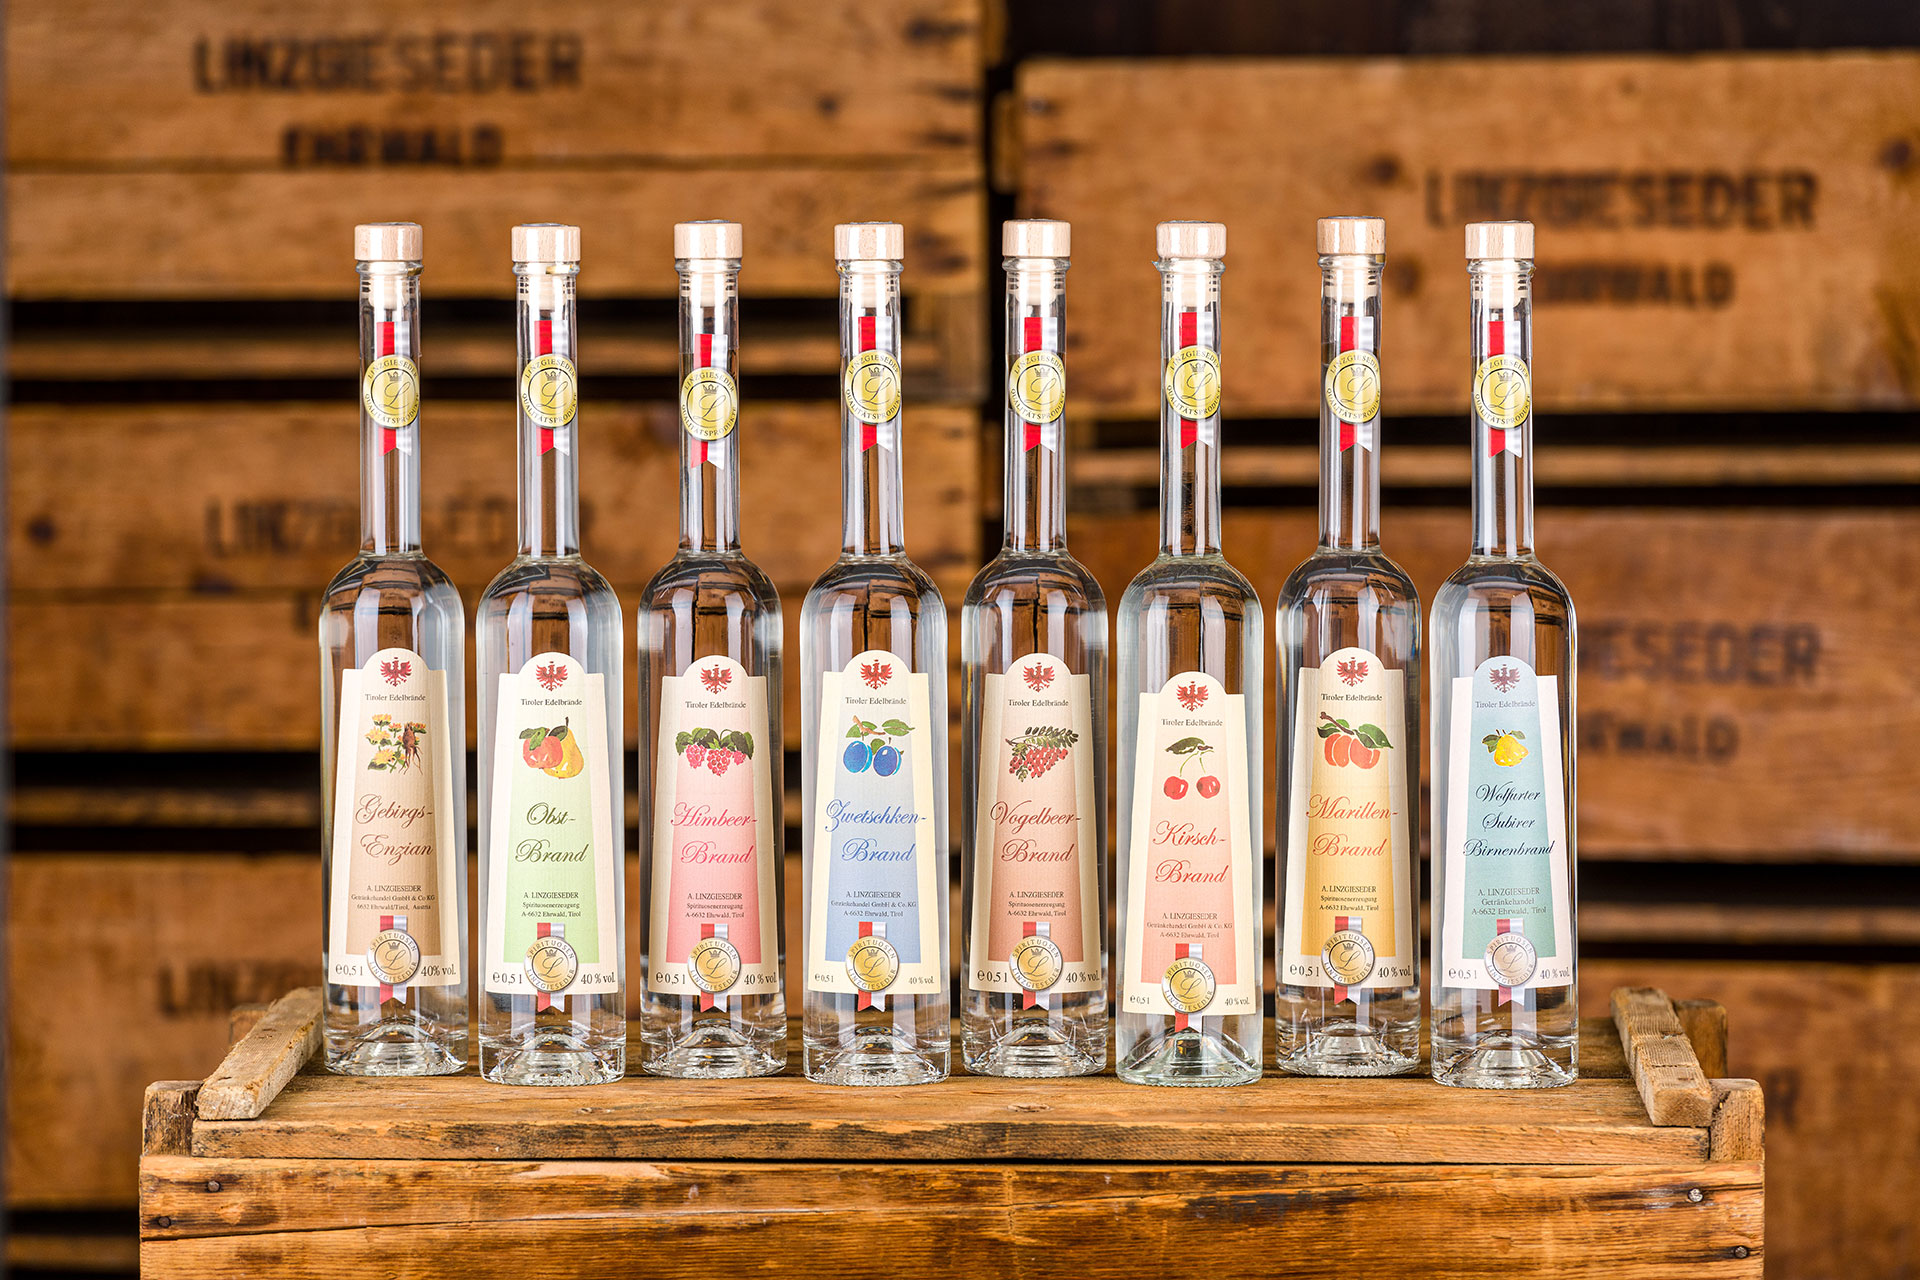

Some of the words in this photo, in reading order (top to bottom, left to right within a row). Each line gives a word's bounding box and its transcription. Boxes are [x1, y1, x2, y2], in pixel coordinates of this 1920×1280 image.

[845, 697, 868, 705] Tiroler
[869, 697, 907, 705] Edelbrände
[1321, 693, 1344, 701] Tiroler
[1475, 781, 1541, 807] Wolfurter
[355, 794, 434, 828] Gebirgs-
[526, 802, 576, 825] Obst-
[670, 802, 758, 827] Himbeer-
[824, 799, 927, 832] Zwetschken-
[990, 800, 1082, 834] Vogelbeer-
[1305, 794, 1398, 819] Marillen-
[1482, 812, 1536, 832] Subirer
[1152, 820, 1226, 846] Kirsch-
[360, 834, 433, 866] Enzian
[515, 839, 589, 862] Brand
[681, 841, 754, 864] Brand
[842, 838, 915, 861] Brand
[1001, 839, 1074, 862] Brand
[1313, 833, 1387, 857] Brand
[1463, 838, 1555, 856] Birnenbrand
[1155, 859, 1229, 883] Brand
[1488, 888, 1540, 896] LINZGIESEDER
[370, 932, 417, 952] SPIRITUOSEN
[527, 940, 574, 959] SPIRITUOSEN
[690, 941, 738, 960] SPIRITUOSEN
[848, 940, 896, 959] SPIRITUOSEN
[1012, 939, 1059, 958] SPIRITUOSEN
[1324, 934, 1372, 953] SPIRITUOSEN
[1487, 936, 1533, 955] SPIRITUOSEN
[370, 961, 418, 982] LINZGIESEDER
[421, 966, 440, 976] 40%
[527, 968, 575, 990] LINZGIESEDER
[581, 974, 592, 984] 40
[595, 973, 601, 983] %
[690, 970, 738, 991] LINZGIESEDER
[744, 974, 755, 984] 40
[757, 974, 764, 983] %
[848, 968, 896, 989] LINZGIESEDER
[1012, 968, 1060, 989] LINZGIESEDER
[1066, 972, 1078, 983] 40
[1079, 972, 1086, 982] %
[1165, 961, 1213, 980] SPIRITUOSEN
[1324, 962, 1372, 983] LINZGIESEDER
[1378, 967, 1389, 978] 40
[1391, 966, 1397, 976] %
[1487, 963, 1534, 985] LINZGIESEDER
[1540, 970, 1550, 979] 40
[1165, 990, 1213, 1011] LINZGIESEDER
